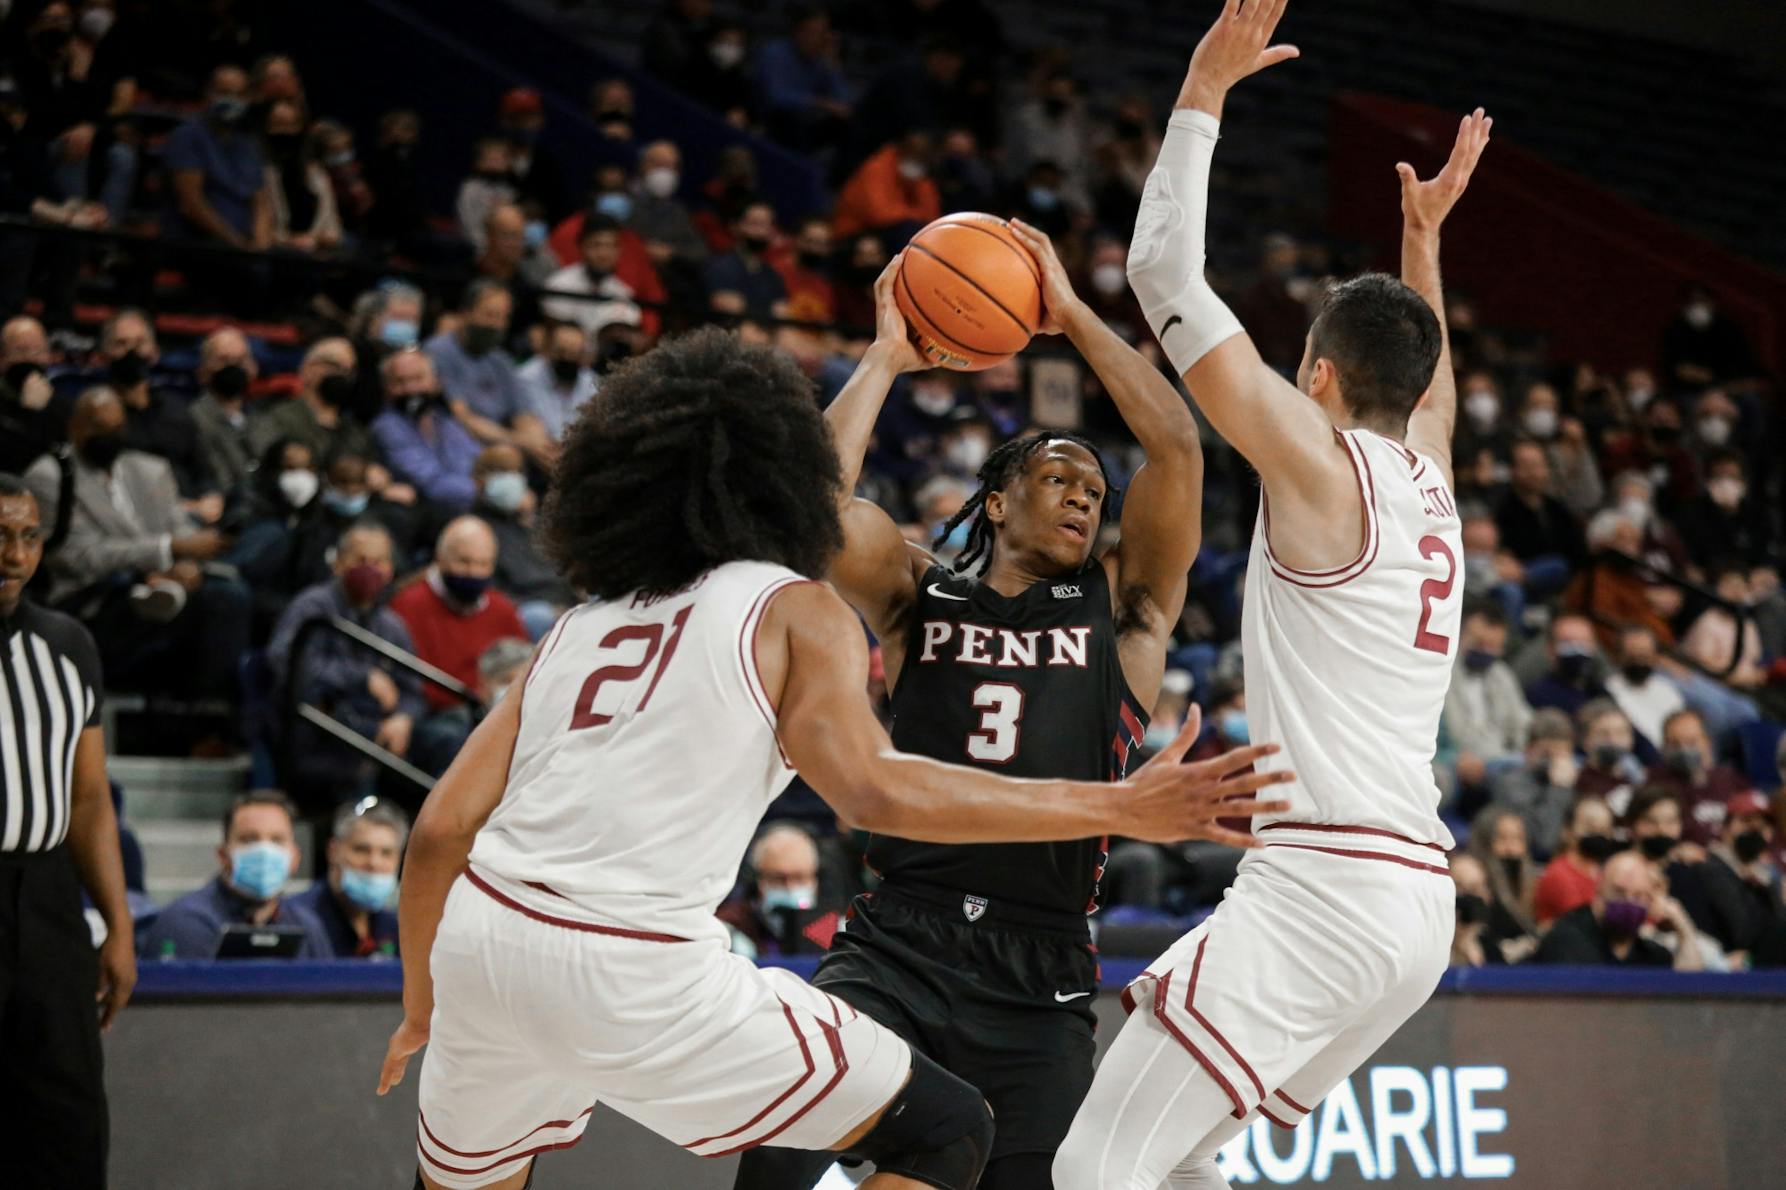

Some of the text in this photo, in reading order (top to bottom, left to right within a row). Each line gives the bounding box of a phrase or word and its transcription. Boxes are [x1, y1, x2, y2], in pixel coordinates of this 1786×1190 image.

[1060, 585, 1080, 595] IVY
[1414, 535, 1456, 656] 2
[568, 603, 696, 731] 21
[920, 621, 1091, 668] PENN
[966, 681, 1025, 764] 3
